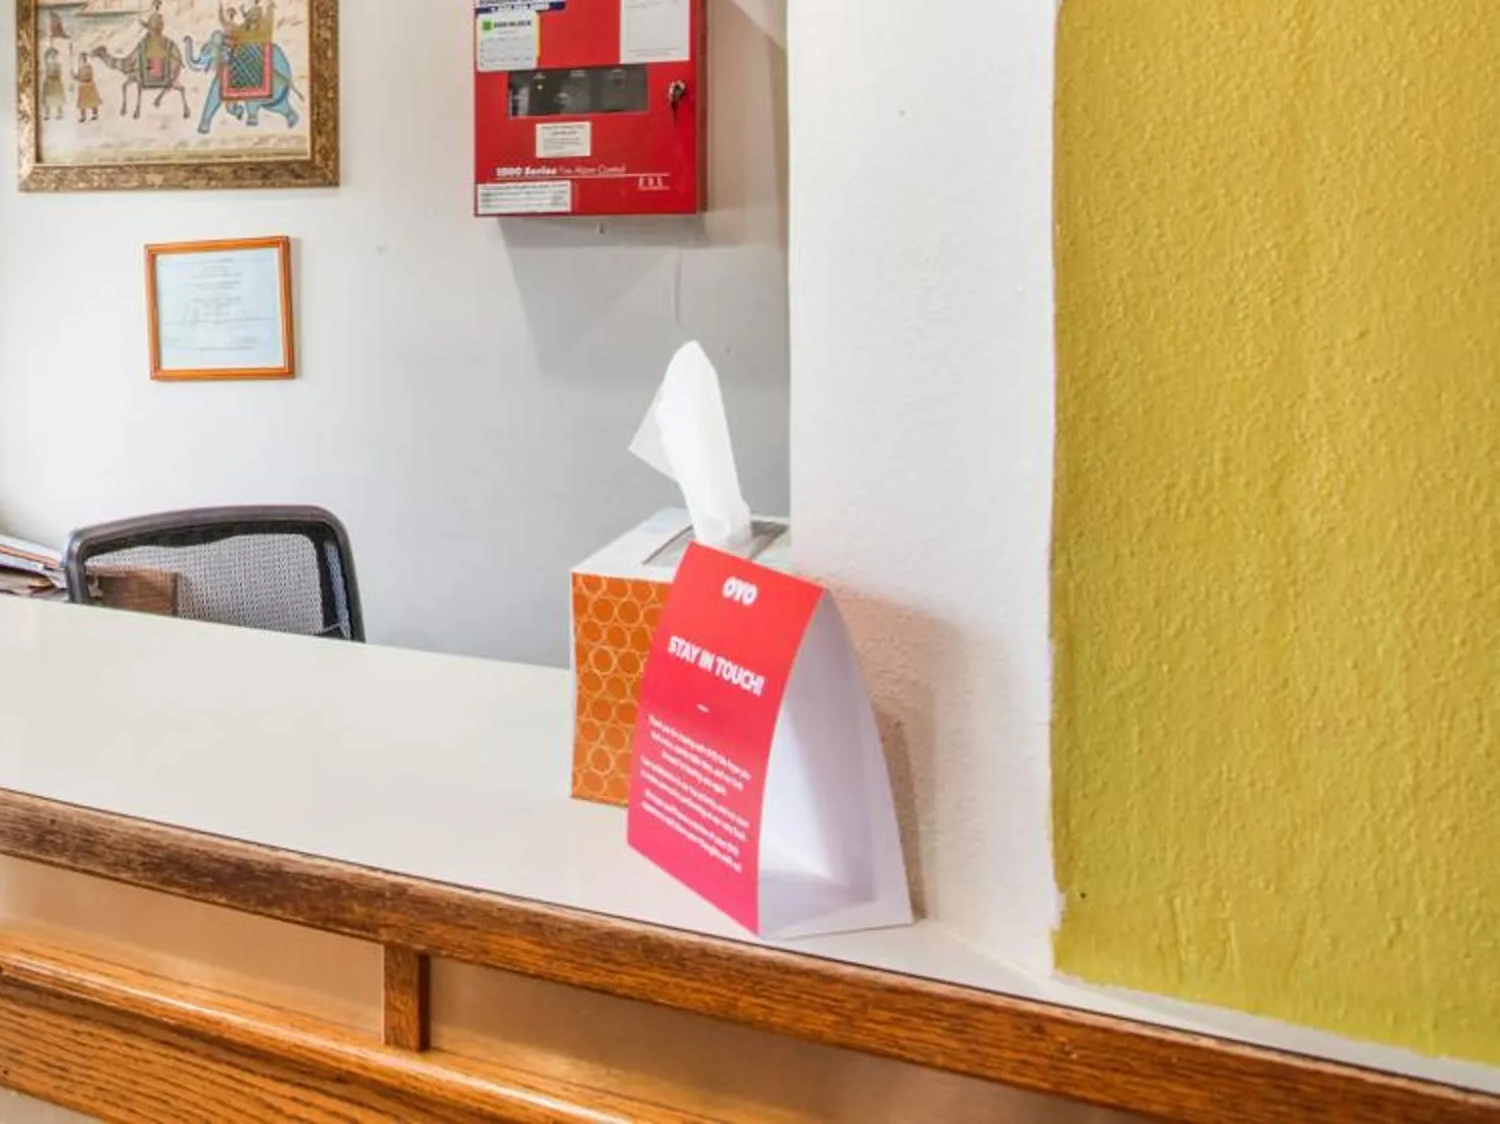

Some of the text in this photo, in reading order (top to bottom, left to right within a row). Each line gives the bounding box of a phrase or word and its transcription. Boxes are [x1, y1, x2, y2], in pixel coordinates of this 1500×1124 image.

[524, 165, 557, 176] Series
[722, 575, 758, 606] OYO
[667, 635, 765, 697] STAY IN TOUCH!
